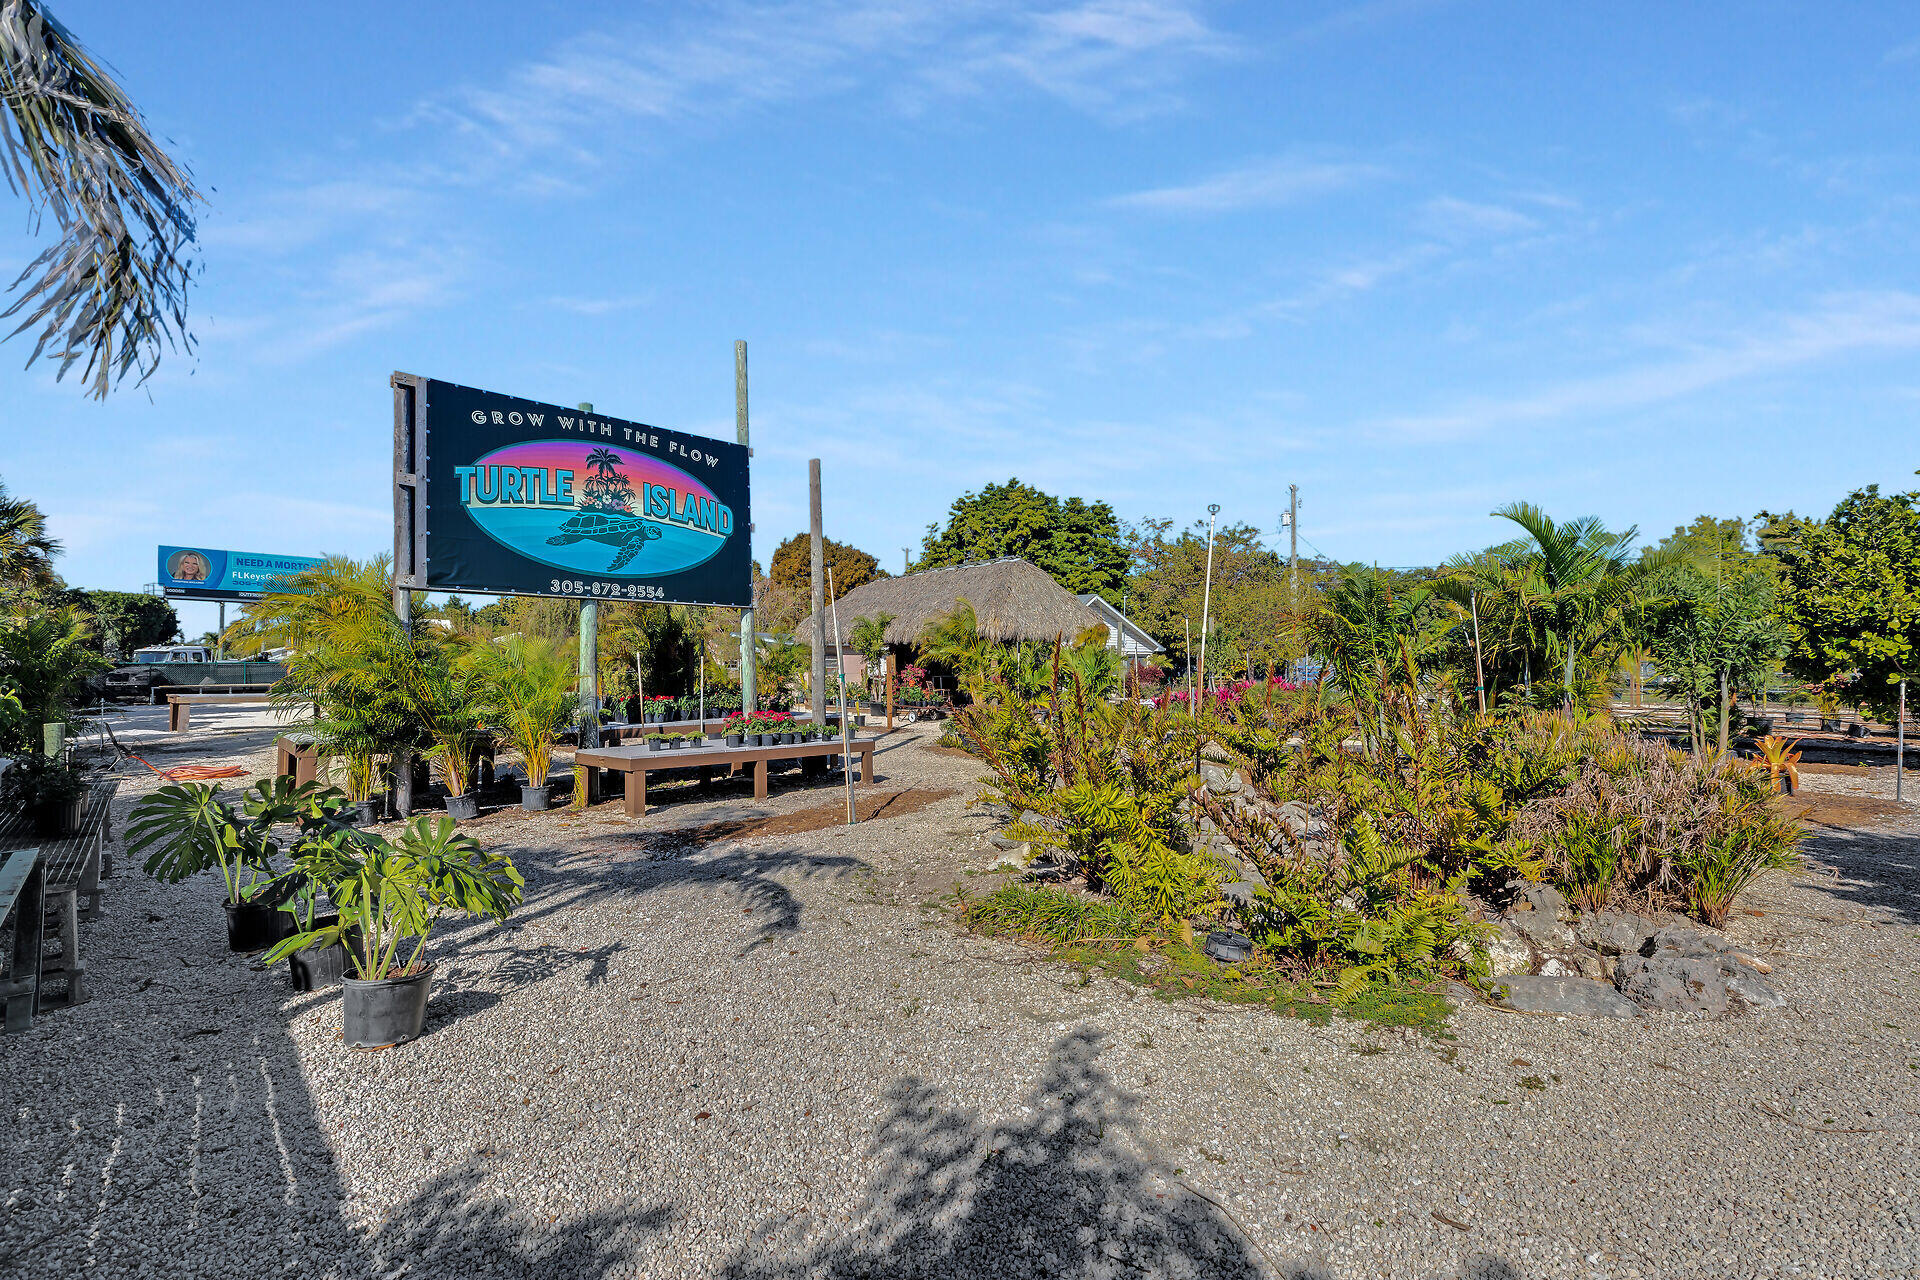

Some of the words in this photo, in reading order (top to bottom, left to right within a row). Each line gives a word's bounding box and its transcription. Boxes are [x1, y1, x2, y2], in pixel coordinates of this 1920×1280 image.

[471, 410, 545, 427] GROW
[557, 415, 612, 436] WITH
[623, 427, 659, 448] THE
[669, 440, 719, 468] FLOW
[454, 464, 575, 506] TURTLE
[642, 481, 734, 537] ISLAND
[236, 557, 264, 567] NEED
[265, 560, 273, 568] A
[550, 579, 665, 599] 305-872-2554
